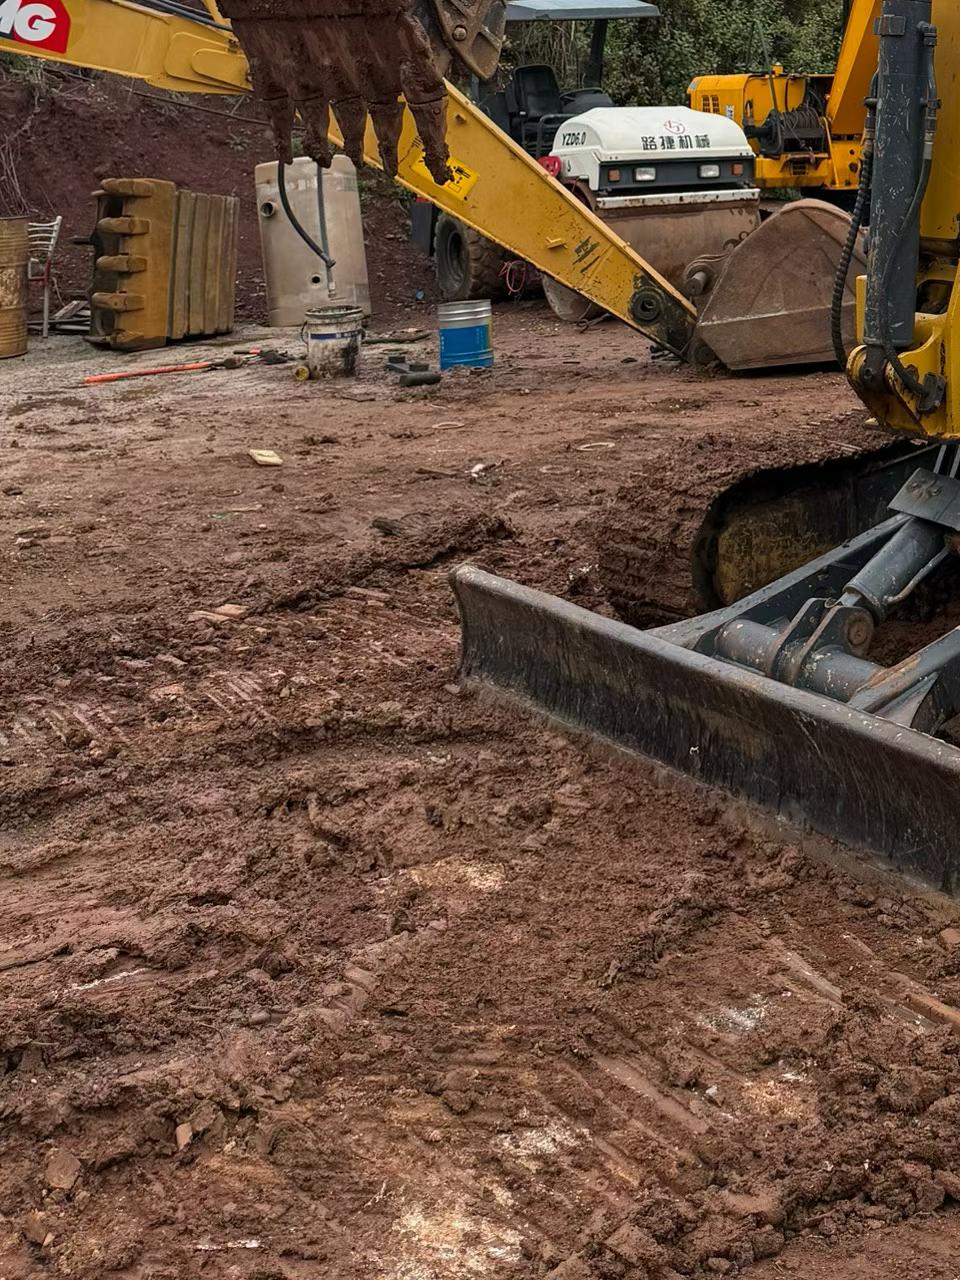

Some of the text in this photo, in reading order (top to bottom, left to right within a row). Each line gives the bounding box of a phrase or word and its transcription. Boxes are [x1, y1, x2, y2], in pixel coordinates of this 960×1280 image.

[561, 132, 587, 146] YZD6.0
[641, 134, 711, 151] 路捷机械
